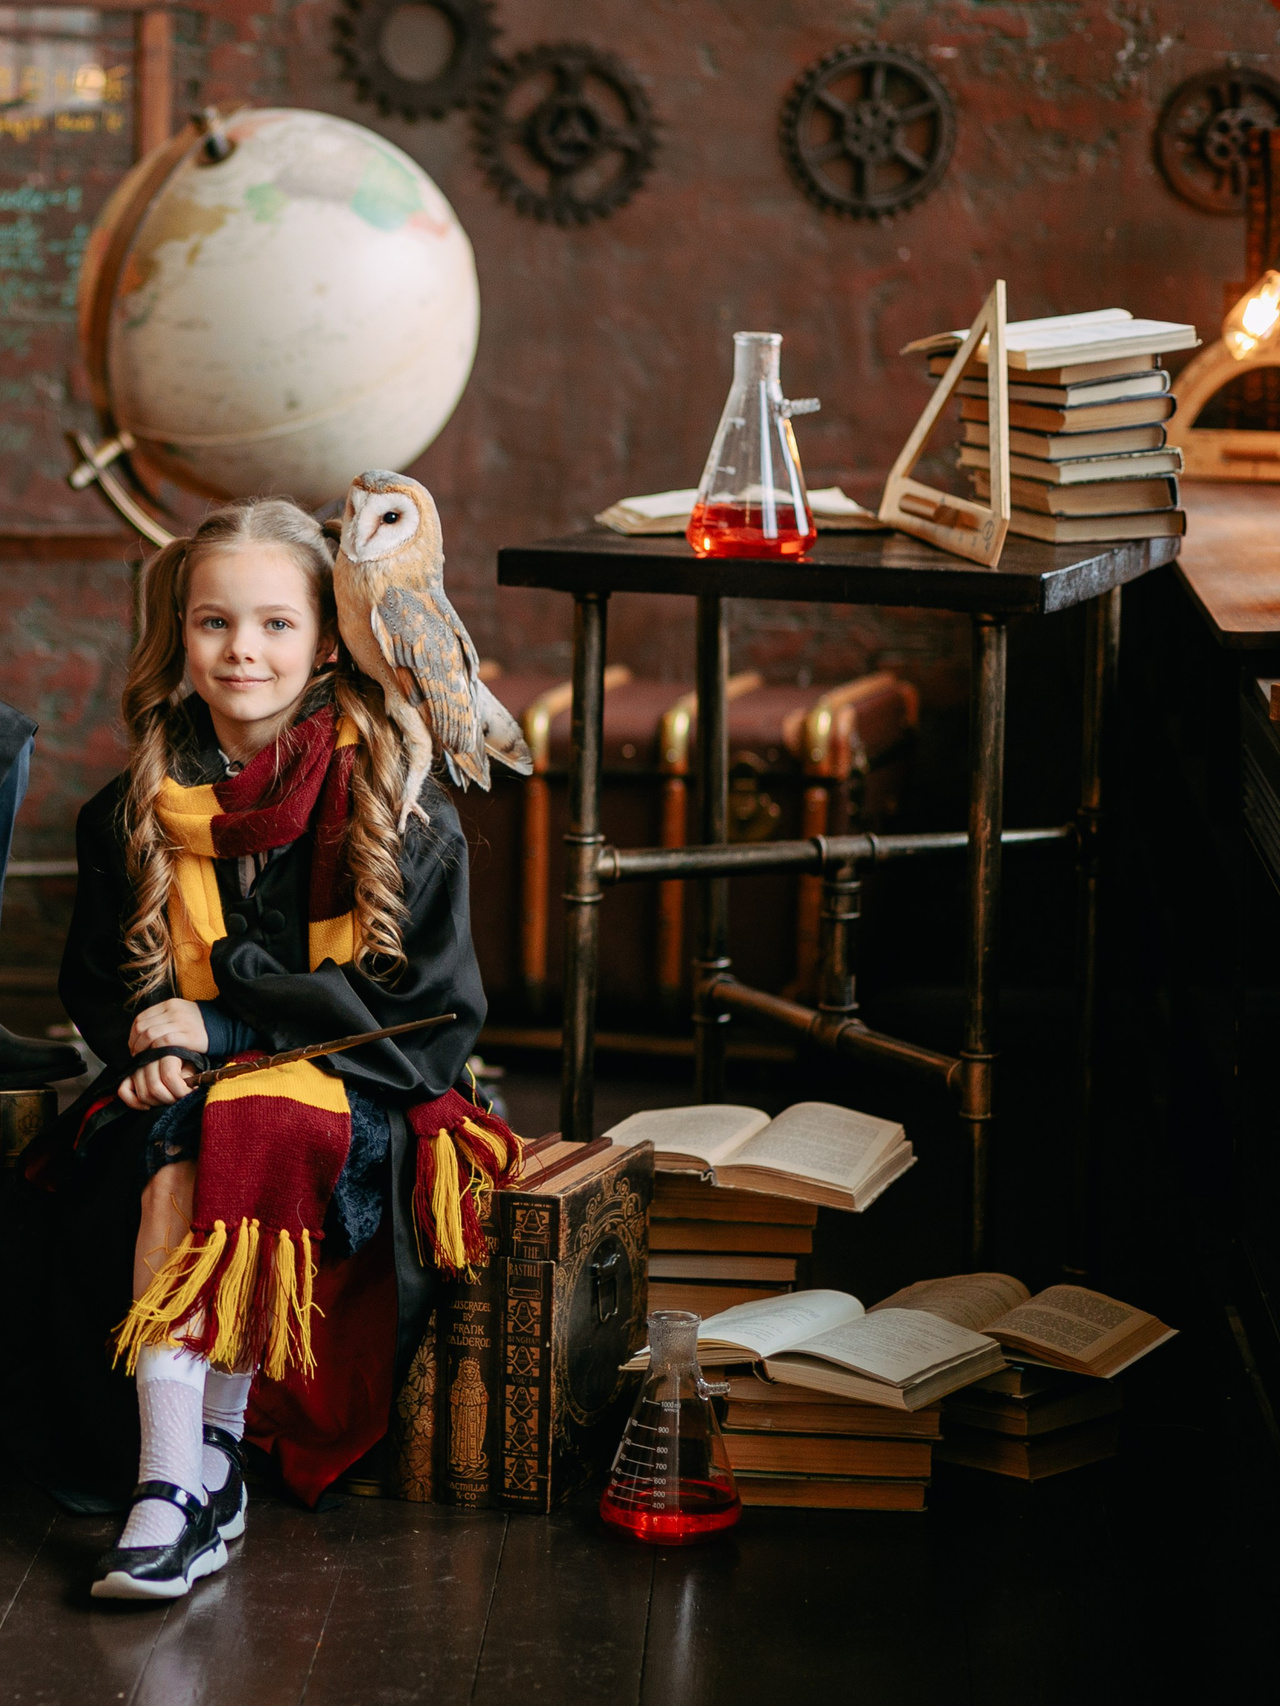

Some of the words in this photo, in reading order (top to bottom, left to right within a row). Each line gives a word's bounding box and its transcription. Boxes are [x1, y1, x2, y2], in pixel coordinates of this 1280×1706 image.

[522, 1245, 540, 1259] THE
[508, 1263, 541, 1278] BASTILLE
[463, 1312, 476, 1322] BY
[453, 1323, 485, 1336] FRANK
[658, 1426, 669, 1434] 900
[651, 1502, 665, 1510] 400
